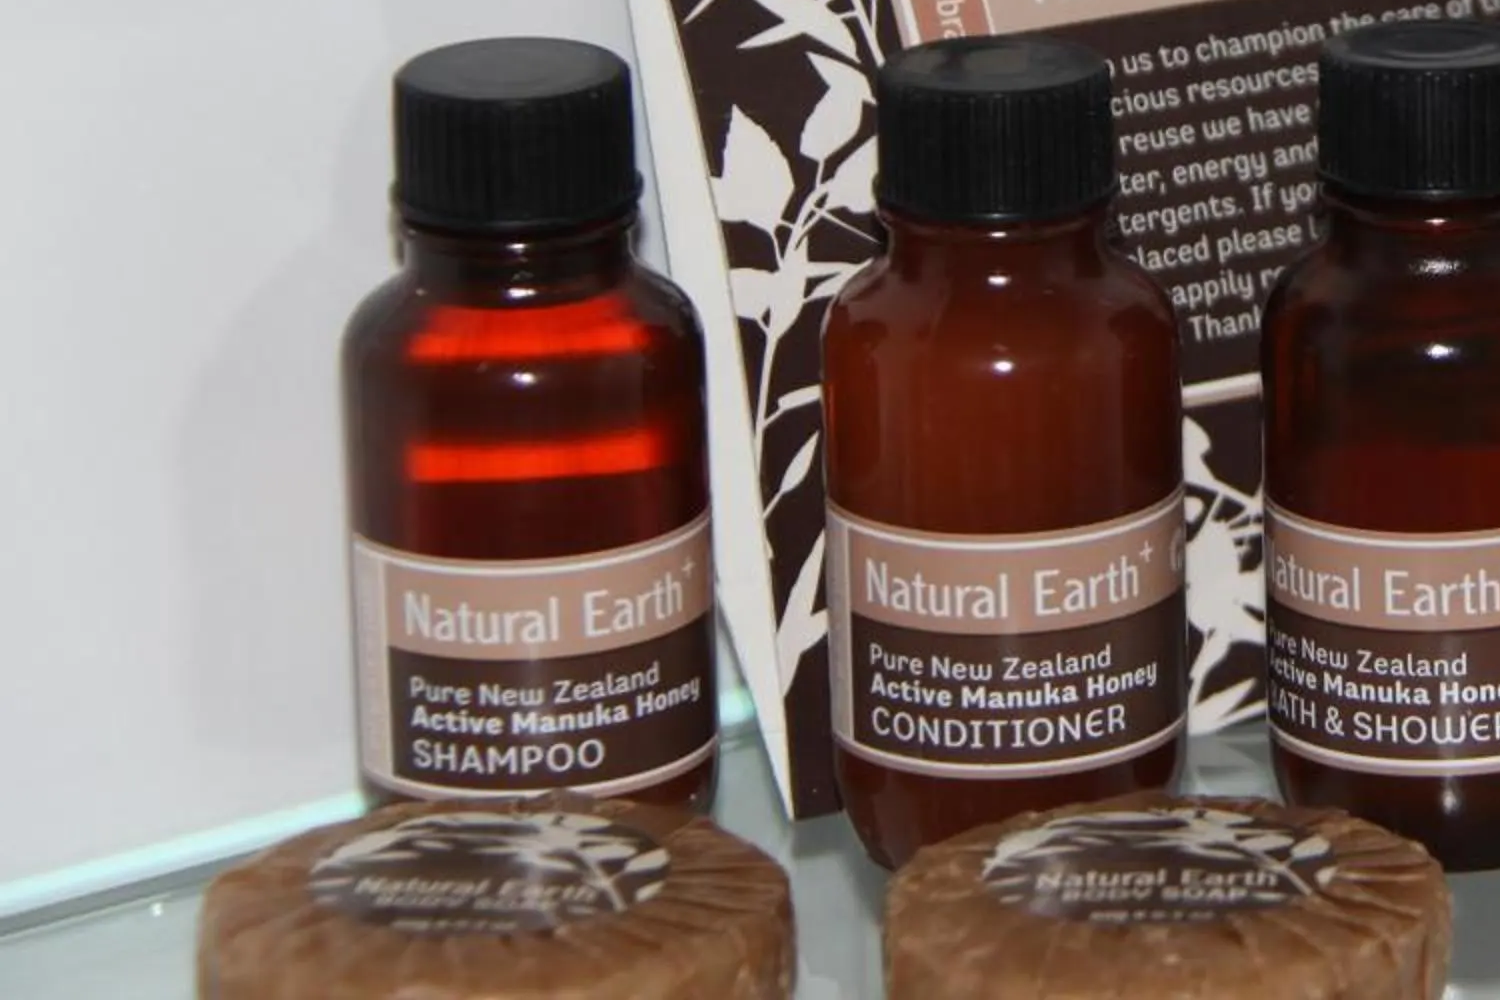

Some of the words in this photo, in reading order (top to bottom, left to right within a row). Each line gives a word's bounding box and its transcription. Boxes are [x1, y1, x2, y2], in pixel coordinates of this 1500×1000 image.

[1121, 52, 1153, 75] us
[1158, 44, 1190, 69] to
[1195, 20, 1325, 63] champion
[1110, 87, 1181, 118] cious
[1186, 60, 1319, 104] resources
[1119, 122, 1196, 156] reuse
[1202, 115, 1243, 142] we
[1246, 102, 1311, 132] have
[1118, 169, 1167, 196] ter,
[1172, 151, 1267, 186] energy
[1273, 136, 1319, 168] and
[1117, 195, 1246, 236] tergents.
[1251, 181, 1274, 212] If
[1128, 233, 1210, 271] laced
[1216, 223, 1302, 264] please
[1171, 268, 1255, 310] appily
[864, 556, 1010, 620] Natural
[403, 590, 561, 645] Natural
[869, 642, 924, 676] Pure
[930, 655, 993, 682] New
[1002, 643, 1112, 682] Zealand
[1300, 636, 1349, 672] New
[1356, 647, 1468, 678] Zealand
[409, 675, 472, 706] Pure
[478, 682, 545, 708] New
[552, 660, 661, 704] Zealand
[410, 704, 505, 736] Active
[511, 702, 630, 736] Manuka
[635, 674, 702, 718] Honey
[870, 672, 953, 709] Active
[960, 681, 1079, 710] Manuka
[1086, 660, 1158, 700] Honey
[1322, 670, 1432, 707] Manuka
[870, 702, 1127, 750] CONDITIONER
[1323, 704, 1346, 738] &
[411, 738, 606, 775] SHAMPOO
[1035, 867, 1169, 891] Natural
[1181, 867, 1280, 888] Earth
